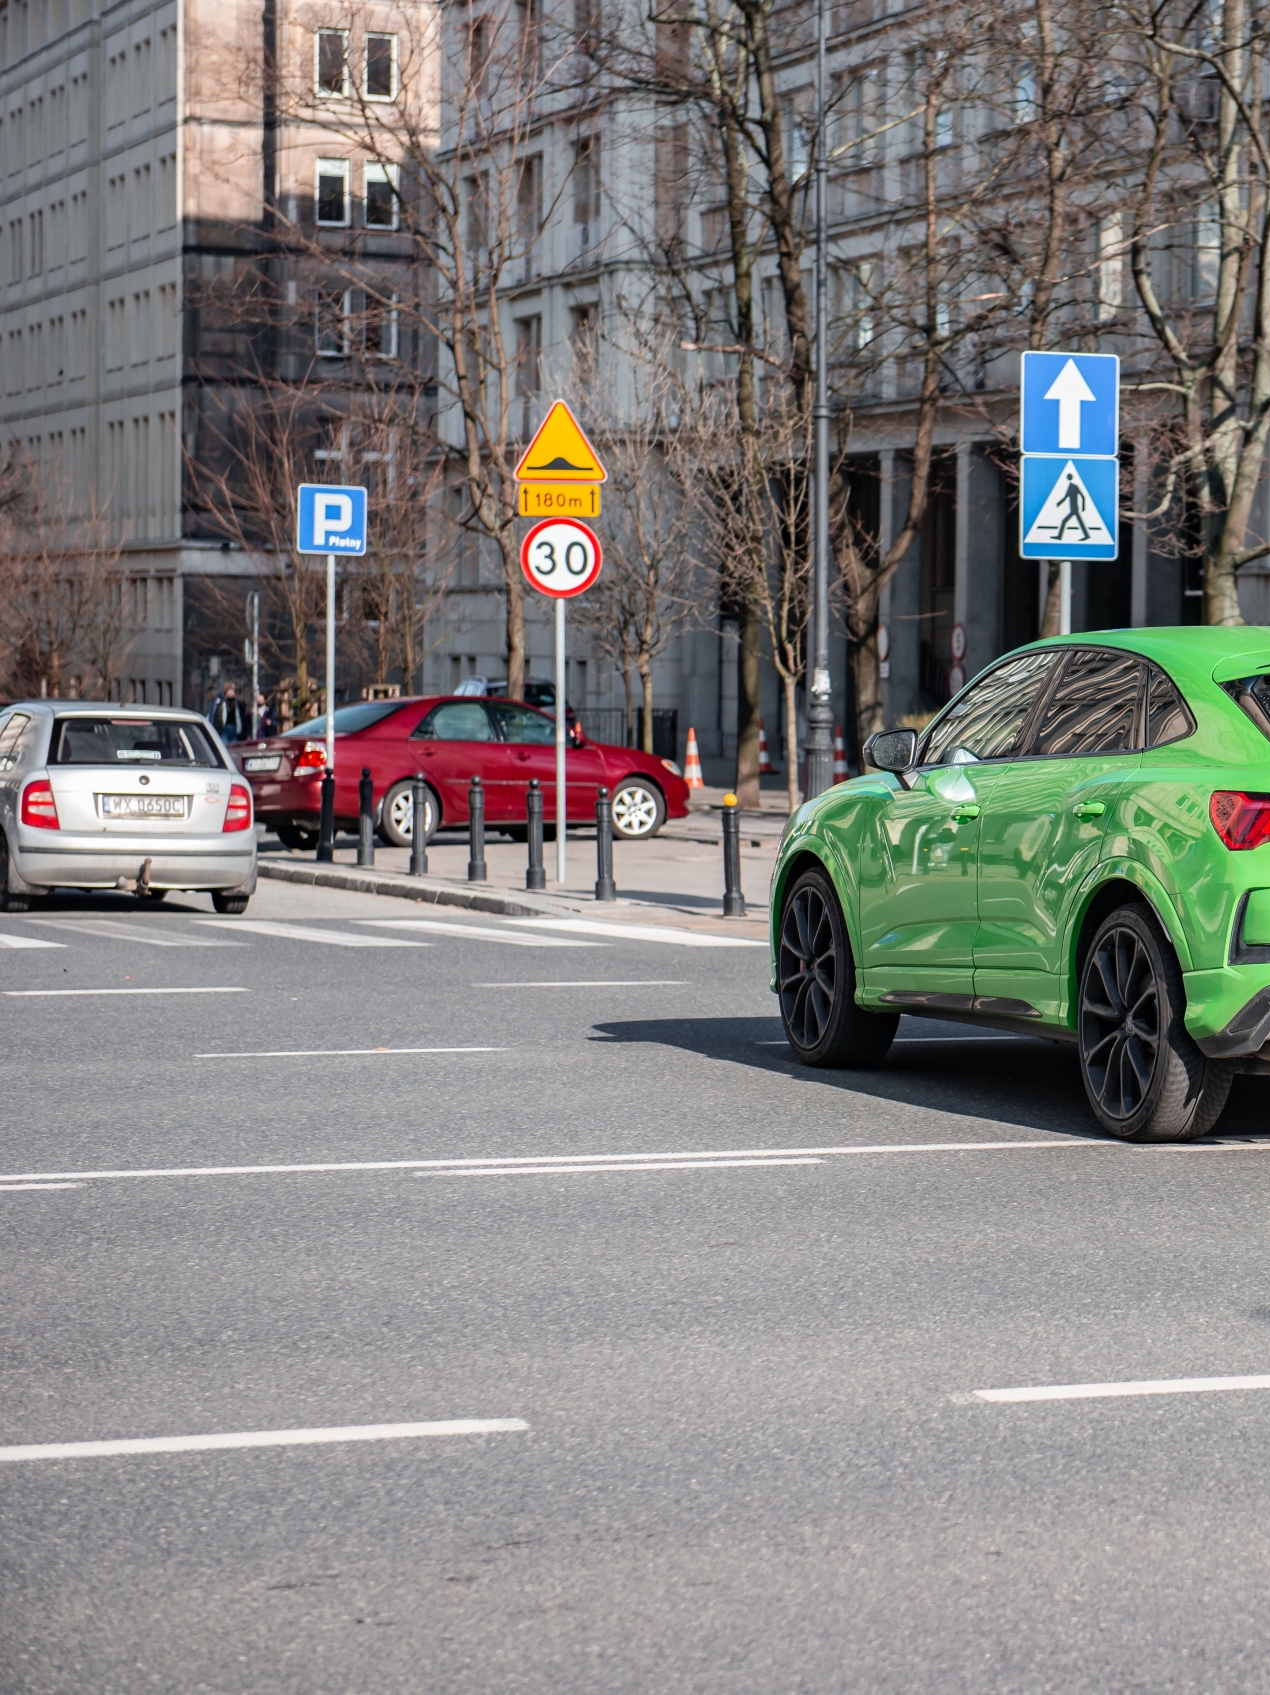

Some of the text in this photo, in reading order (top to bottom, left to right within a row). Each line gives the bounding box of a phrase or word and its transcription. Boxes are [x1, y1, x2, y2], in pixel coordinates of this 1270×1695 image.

[313, 492, 353, 546] P
[328, 535, 362, 551] Płatny
[534, 541, 588, 576] 30
[113, 798, 132, 812] WX
